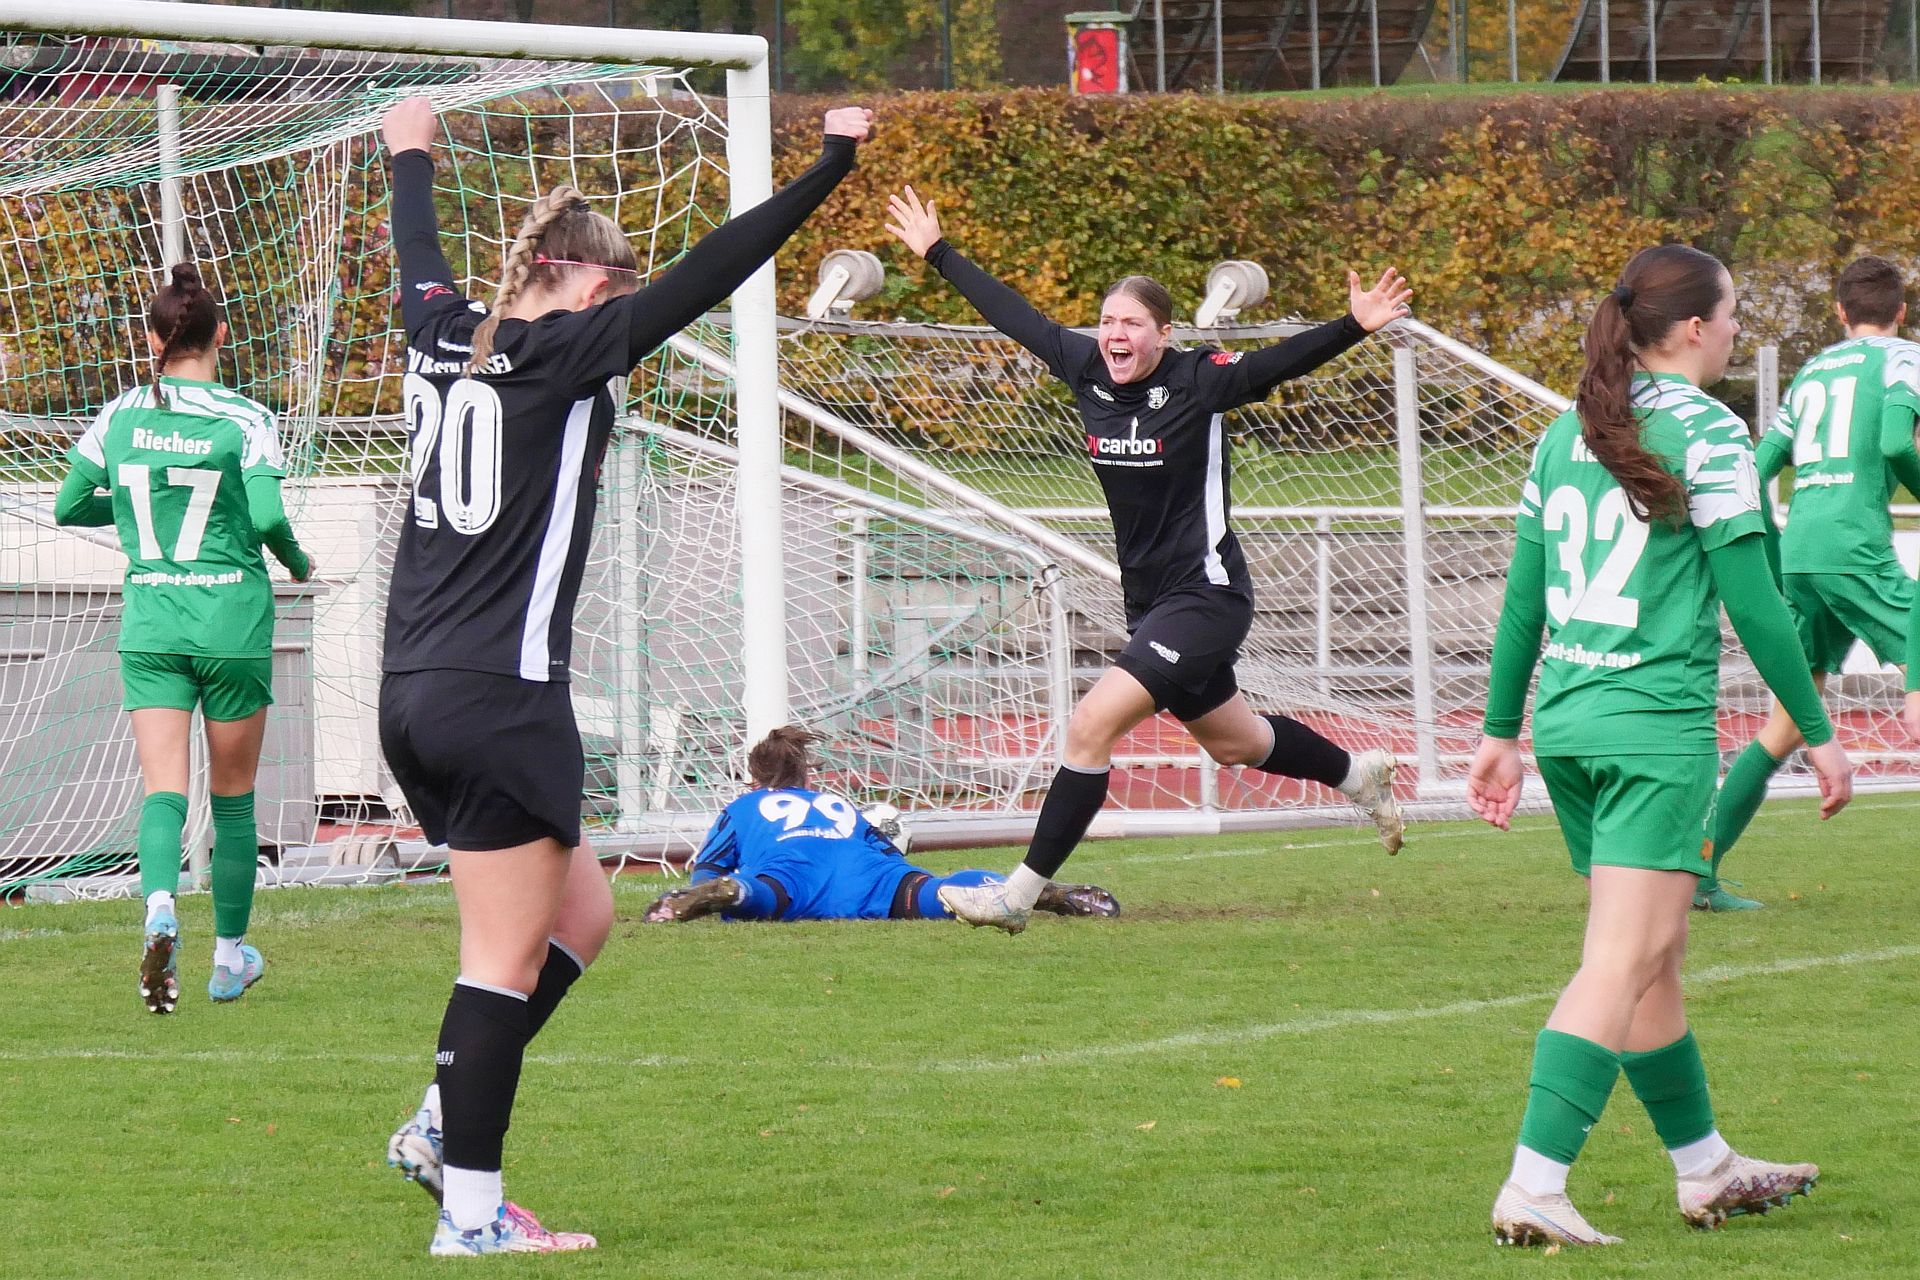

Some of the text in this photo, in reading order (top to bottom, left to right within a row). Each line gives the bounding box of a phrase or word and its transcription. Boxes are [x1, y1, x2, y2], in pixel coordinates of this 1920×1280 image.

[132, 427, 213, 455] Riechers
[402, 373, 503, 535] 20
[1792, 376, 1857, 466] 21
[118, 463, 222, 561] 17
[1543, 485, 1650, 628] 32
[131, 569, 243, 588] magnet-shop.net
[758, 793, 857, 839] 99
